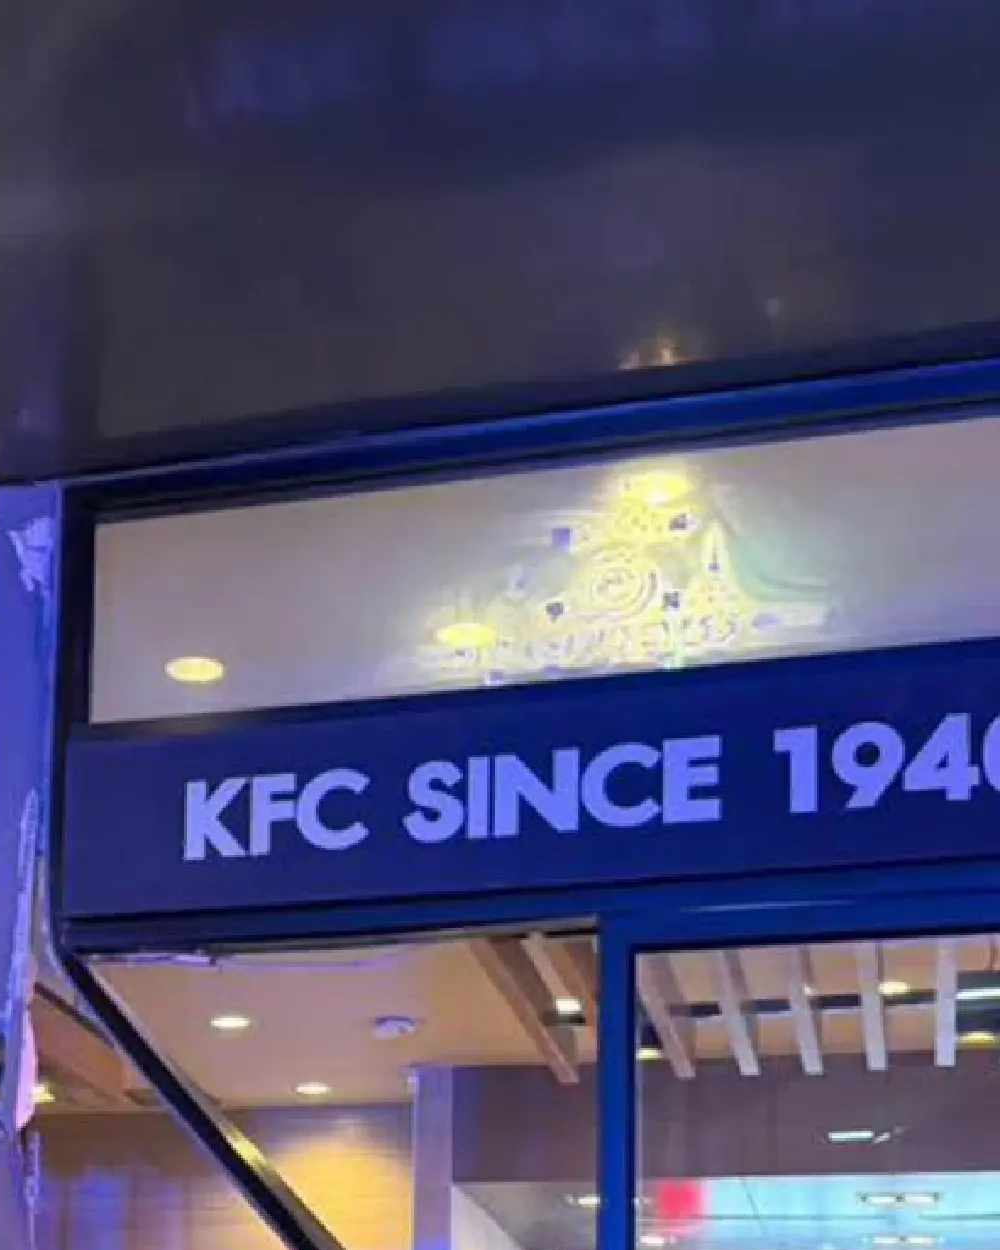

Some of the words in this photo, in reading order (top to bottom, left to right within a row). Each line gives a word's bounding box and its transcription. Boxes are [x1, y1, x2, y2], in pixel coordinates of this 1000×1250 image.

[184, 769, 369, 861] KFC
[403, 735, 722, 843] SINCE
[774, 713, 1000, 813] 194
